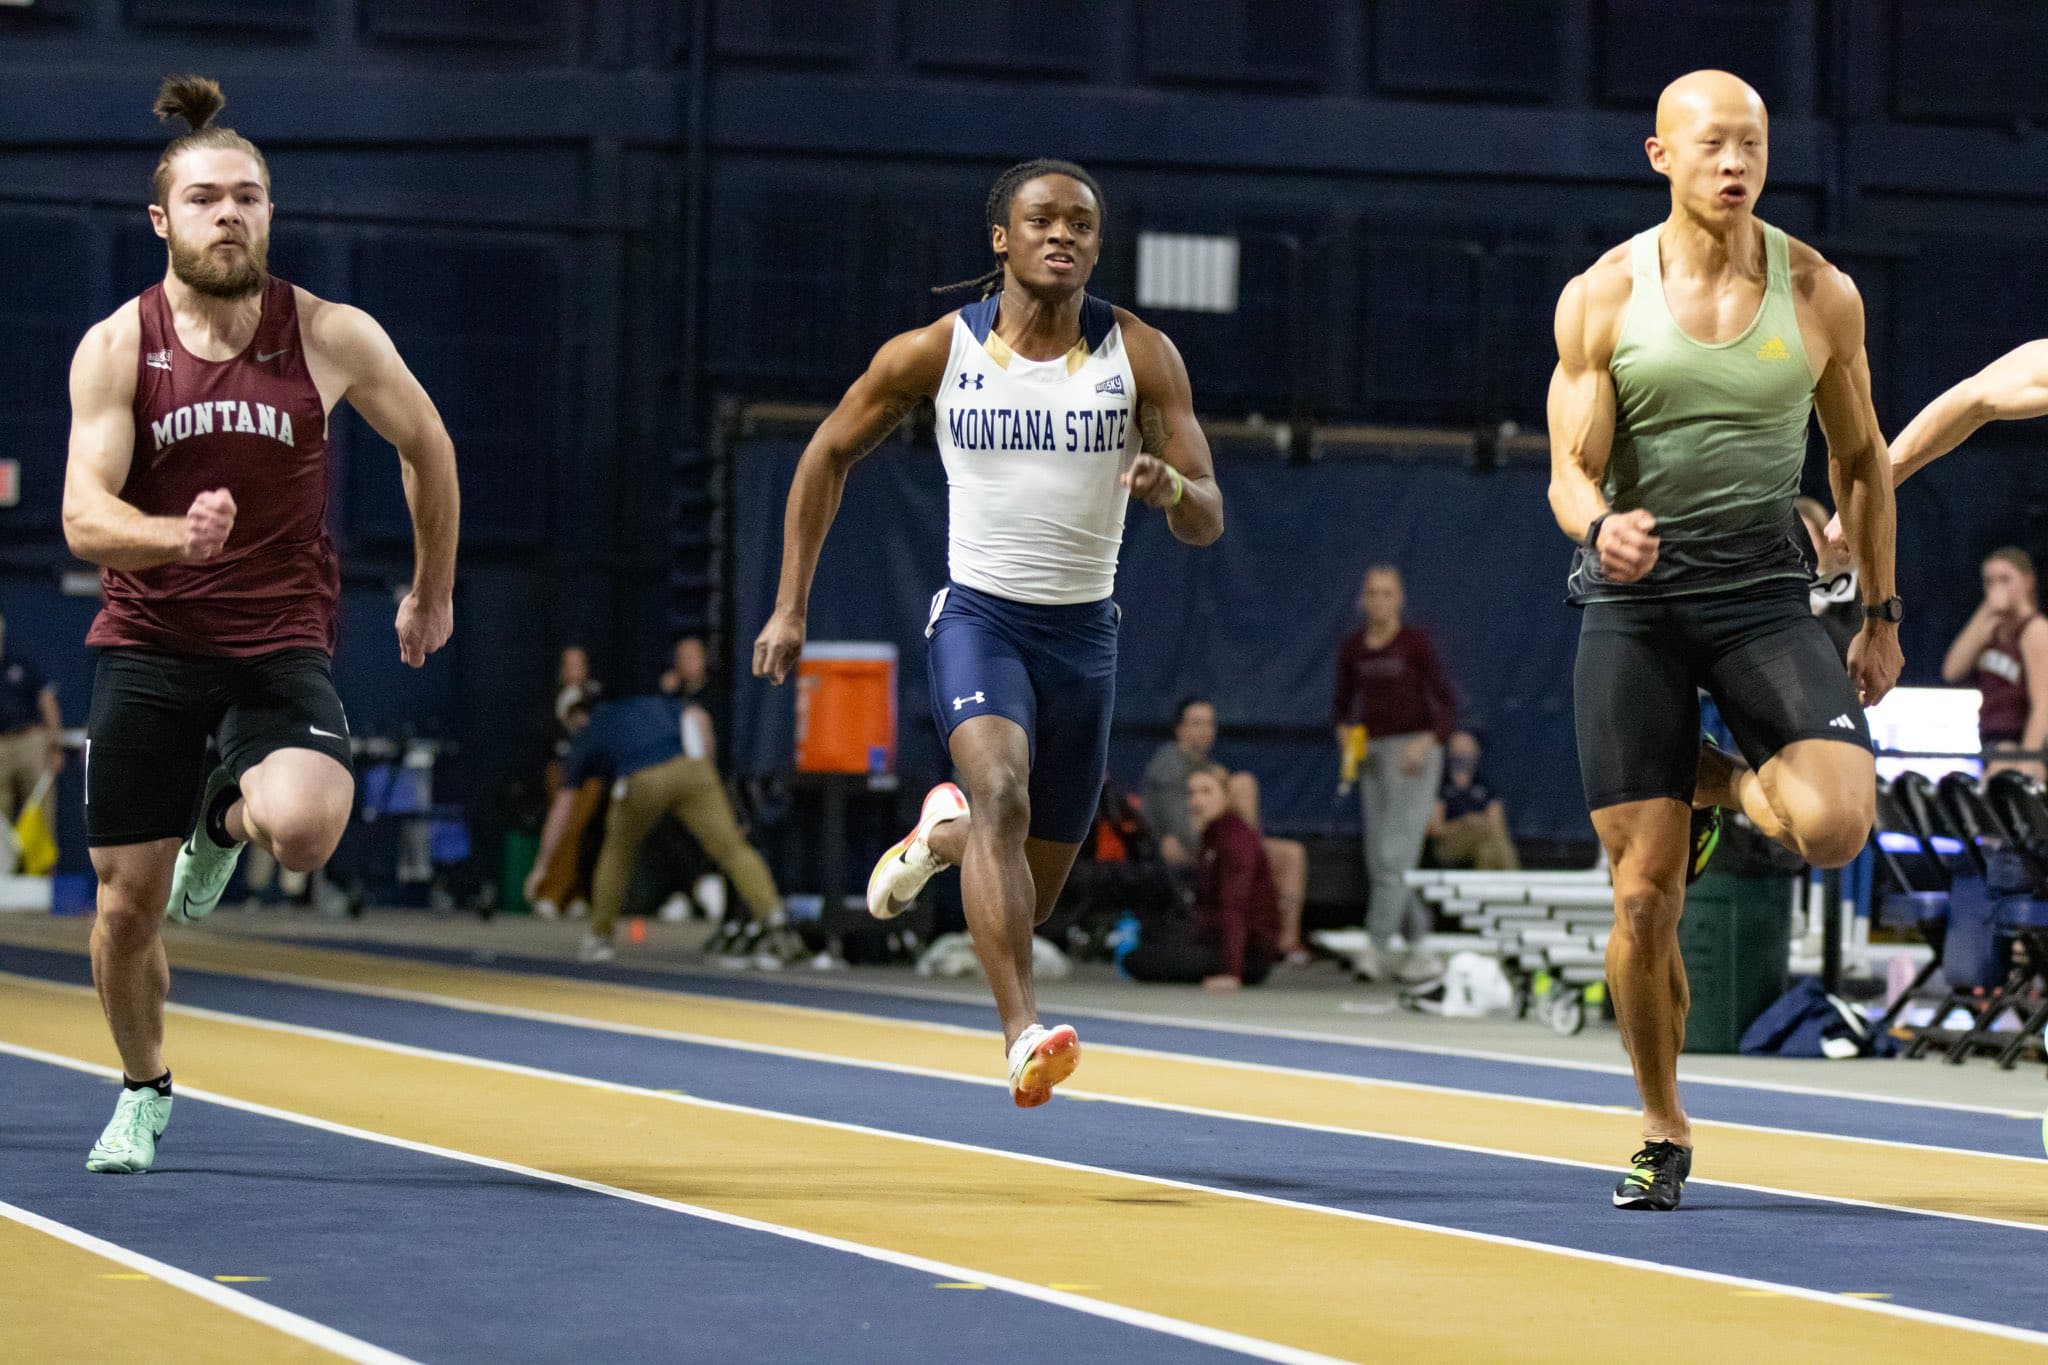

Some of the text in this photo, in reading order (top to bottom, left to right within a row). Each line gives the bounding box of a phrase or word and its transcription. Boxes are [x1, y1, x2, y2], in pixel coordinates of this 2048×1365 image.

[151, 401, 295, 450] MONTANA
[949, 408, 1129, 452] MONTANA STATE
